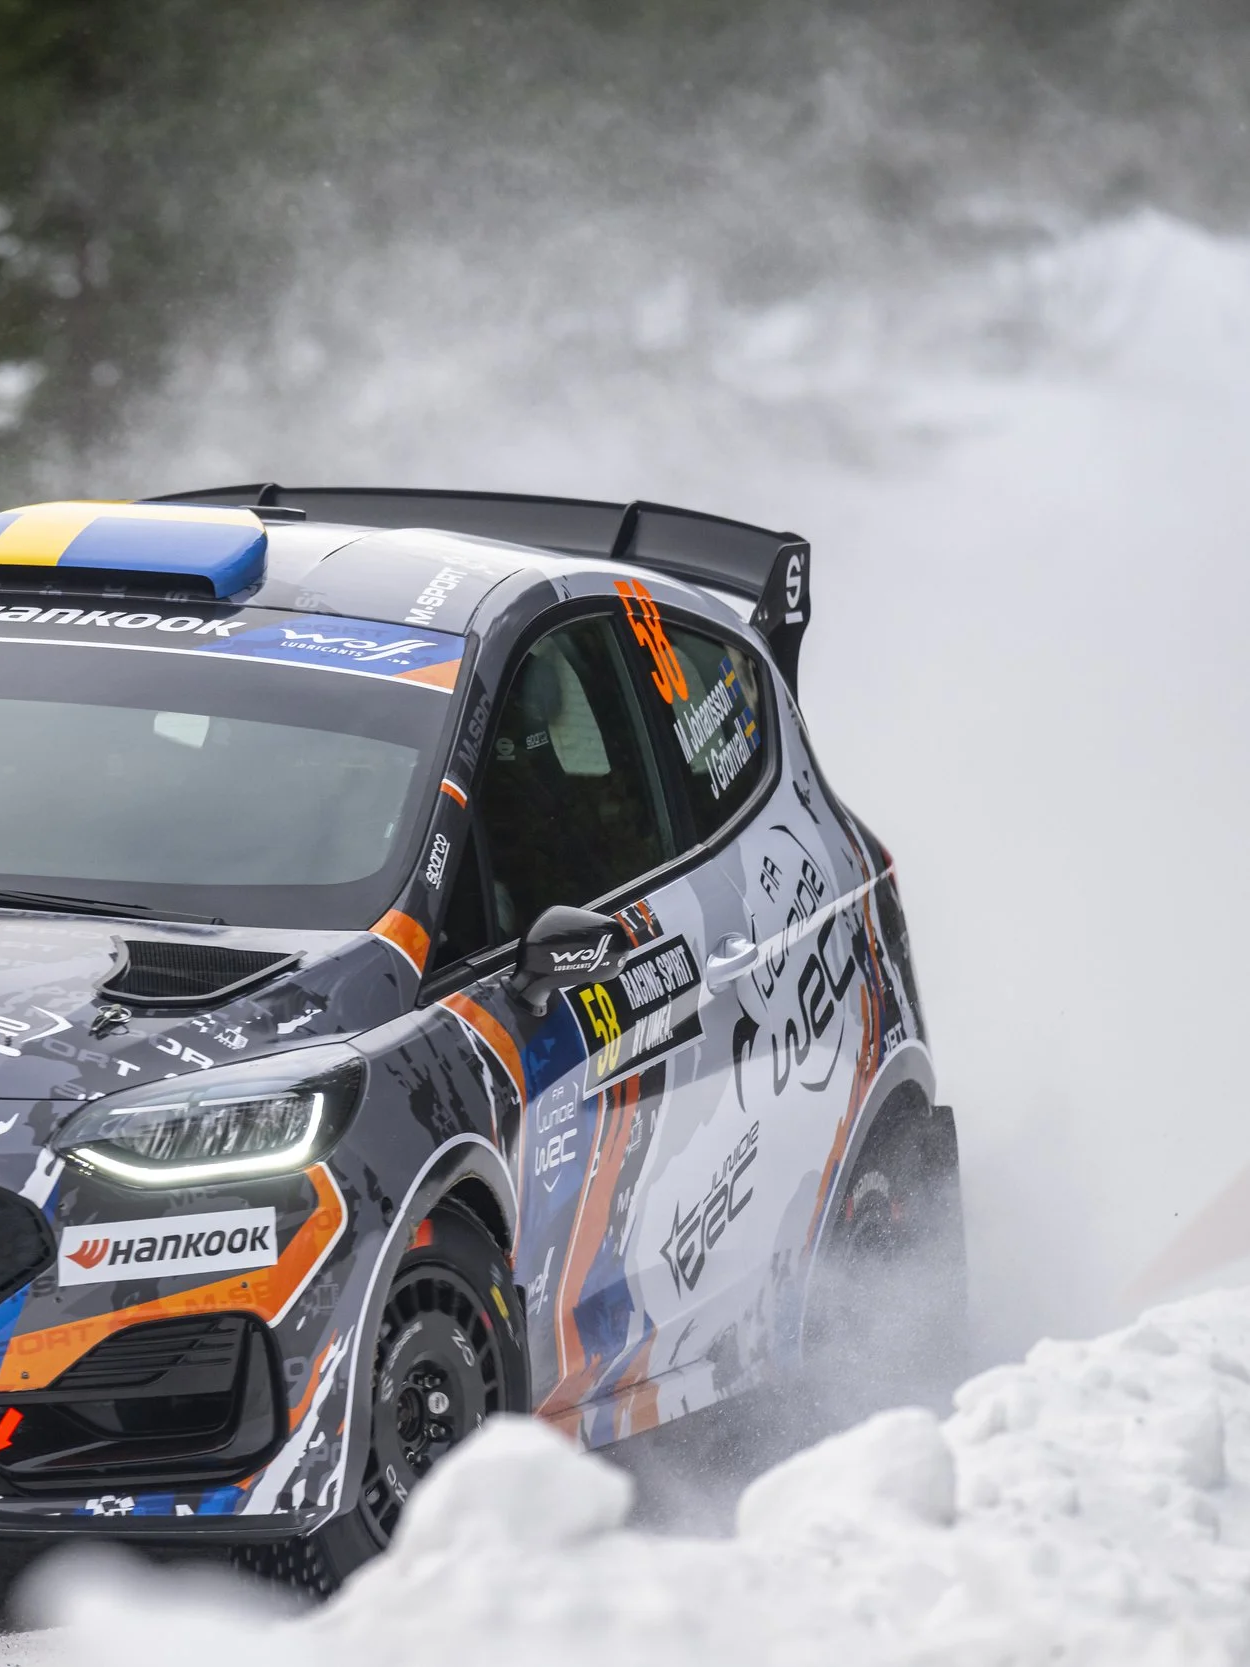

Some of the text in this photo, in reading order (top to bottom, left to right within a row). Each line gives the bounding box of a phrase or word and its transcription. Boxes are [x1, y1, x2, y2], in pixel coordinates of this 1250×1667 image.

[280, 640, 364, 658] LUBRICANTS
[614, 579, 689, 705] 58
[673, 679, 734, 764] M Johansson
[705, 756, 720, 800] J
[426, 833, 450, 890] sparco
[760, 856, 783, 904] FIA
[760, 859, 825, 1000] JUNIOR
[618, 944, 694, 1011] RACING SPIRIT
[772, 905, 856, 1097] WRC
[579, 983, 622, 1077] 58
[535, 1128, 578, 1177] WRC
